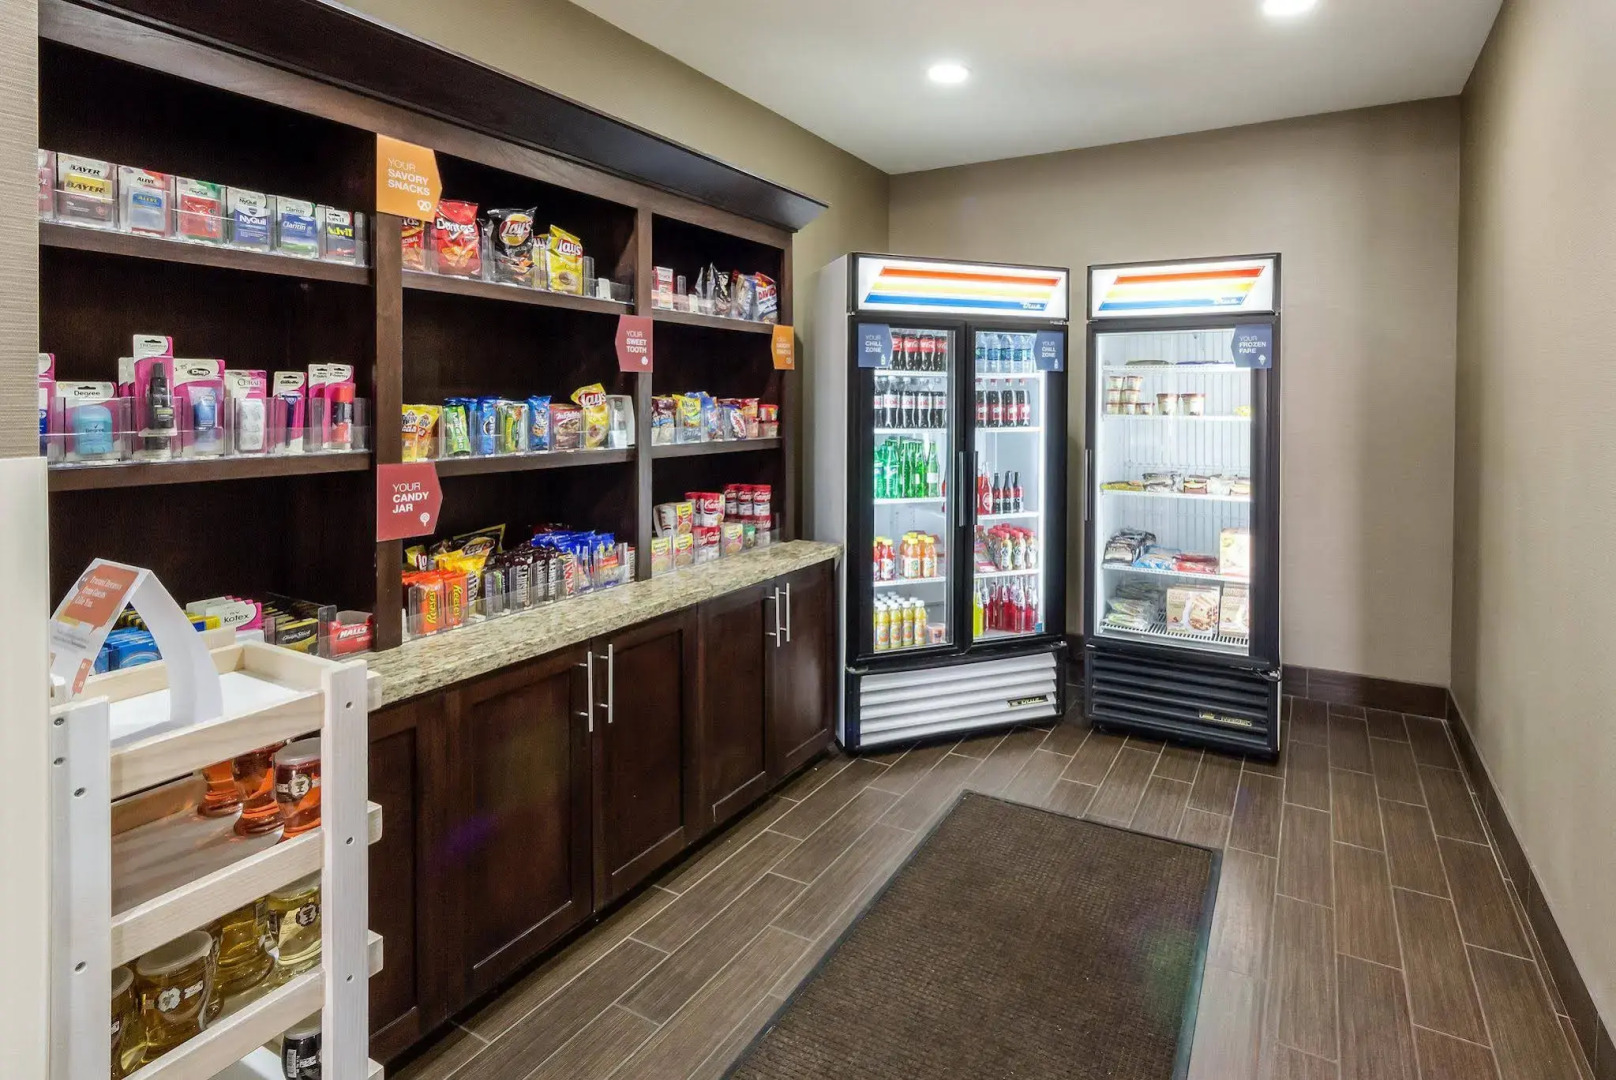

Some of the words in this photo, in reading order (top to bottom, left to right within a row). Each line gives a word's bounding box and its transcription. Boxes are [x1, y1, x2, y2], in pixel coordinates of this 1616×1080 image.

[70, 163, 101, 176] BAYER
[387, 157, 416, 173] YOUR
[387, 168, 430, 186] SAVORY
[66, 180, 106, 194] BAYER
[387, 179, 430, 196] SNACKS
[239, 197, 258, 206] NyQuil
[285, 205, 306, 215] Claritin
[239, 214, 267, 226] NyQuil
[282, 220, 306, 231] Claritin
[436, 217, 475, 234] Doritos
[327, 226, 353, 238] Advil
[626, 330, 643, 338] YOUR
[626, 338, 647, 346] SWEET
[626, 346, 647, 354] TOOTH
[74, 390, 101, 398] Degree
[392, 482, 421, 493] YOUR
[392, 491, 430, 503] CANDY
[392, 503, 414, 514] JAR
[339, 626, 368, 639] HALLS
